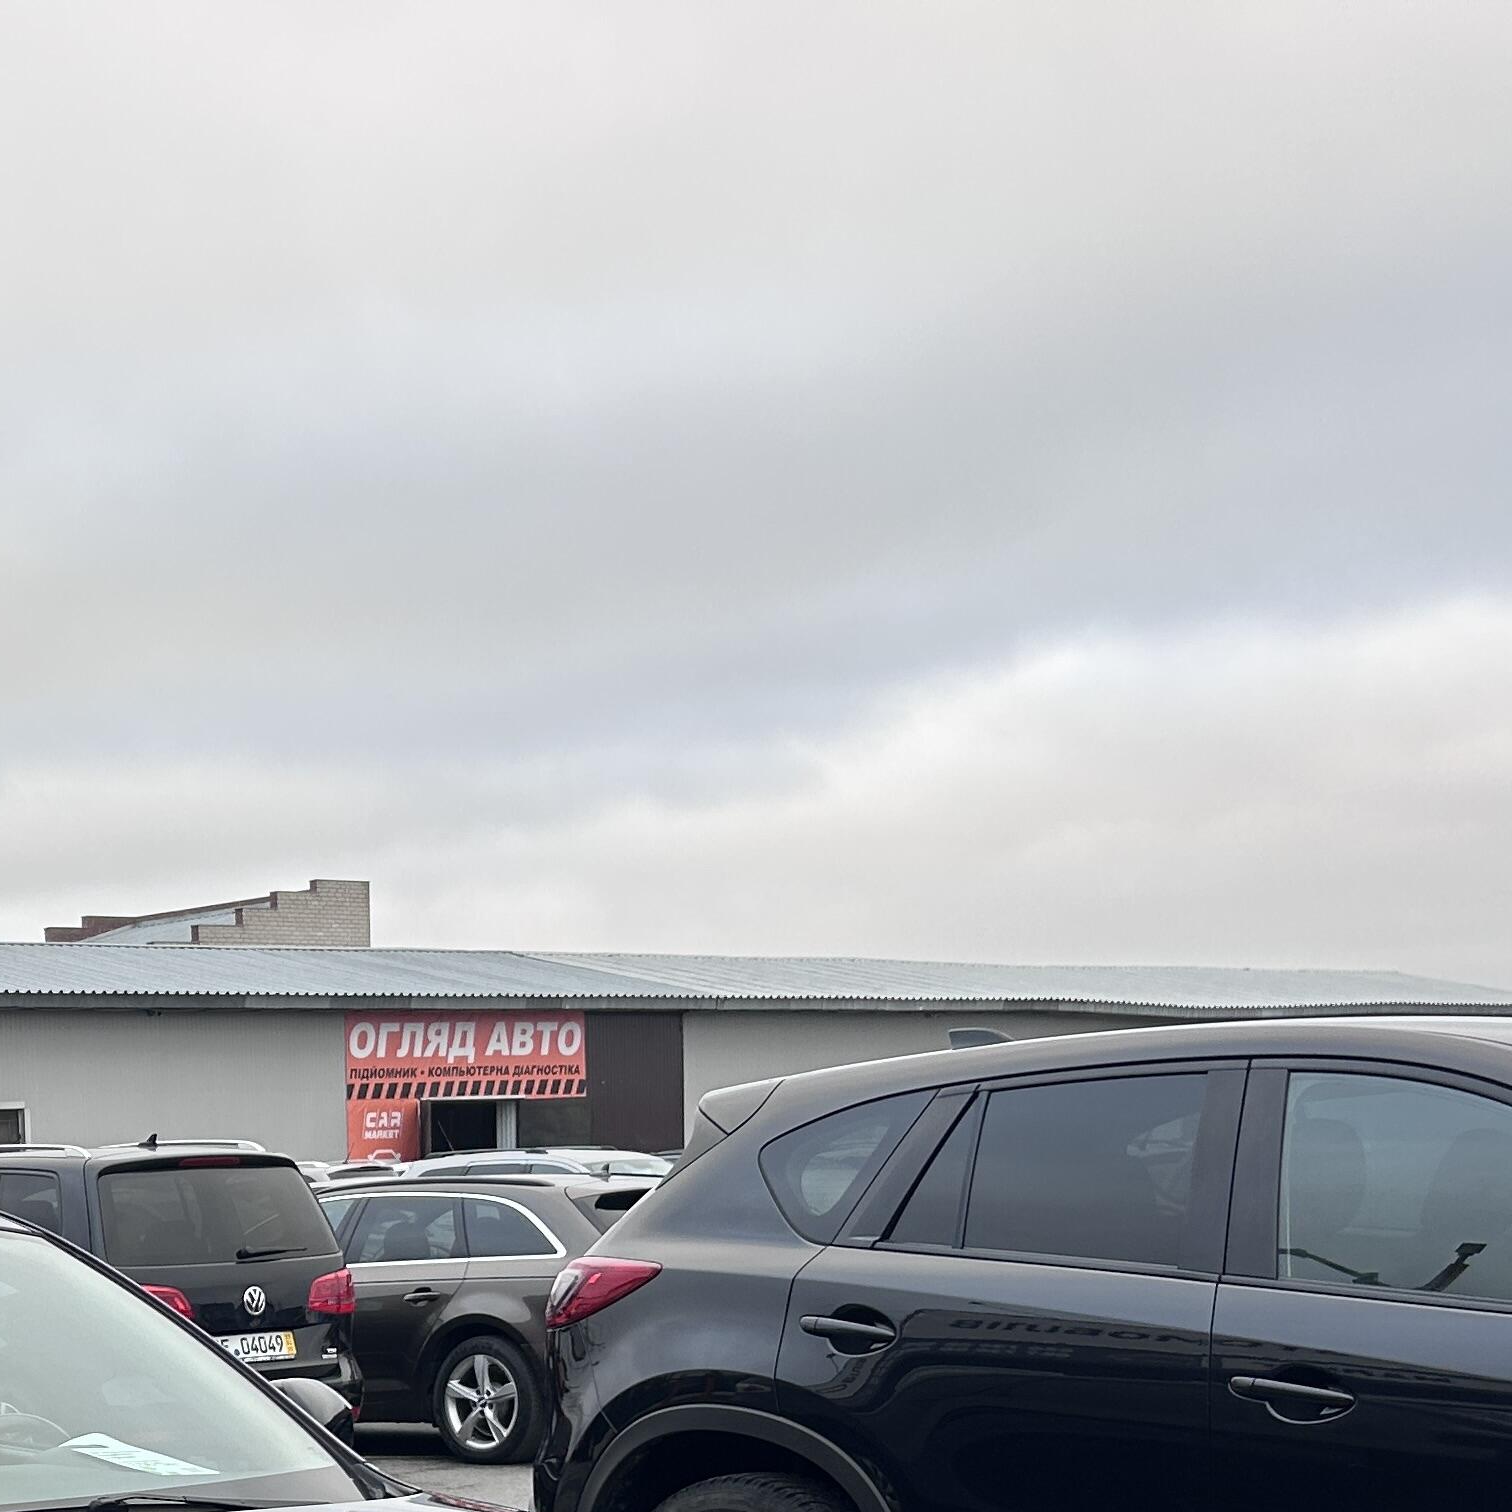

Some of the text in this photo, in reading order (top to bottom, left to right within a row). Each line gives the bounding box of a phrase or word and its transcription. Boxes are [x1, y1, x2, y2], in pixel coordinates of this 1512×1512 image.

[349, 1020, 581, 1063] ОГЛЯД АВТО
[349, 1066, 417, 1080] ПІДЙОМНИК
[365, 1111, 401, 1128] CAR
[363, 1129, 399, 1140] MARKET
[240, 1333, 284, 1355] 04049
